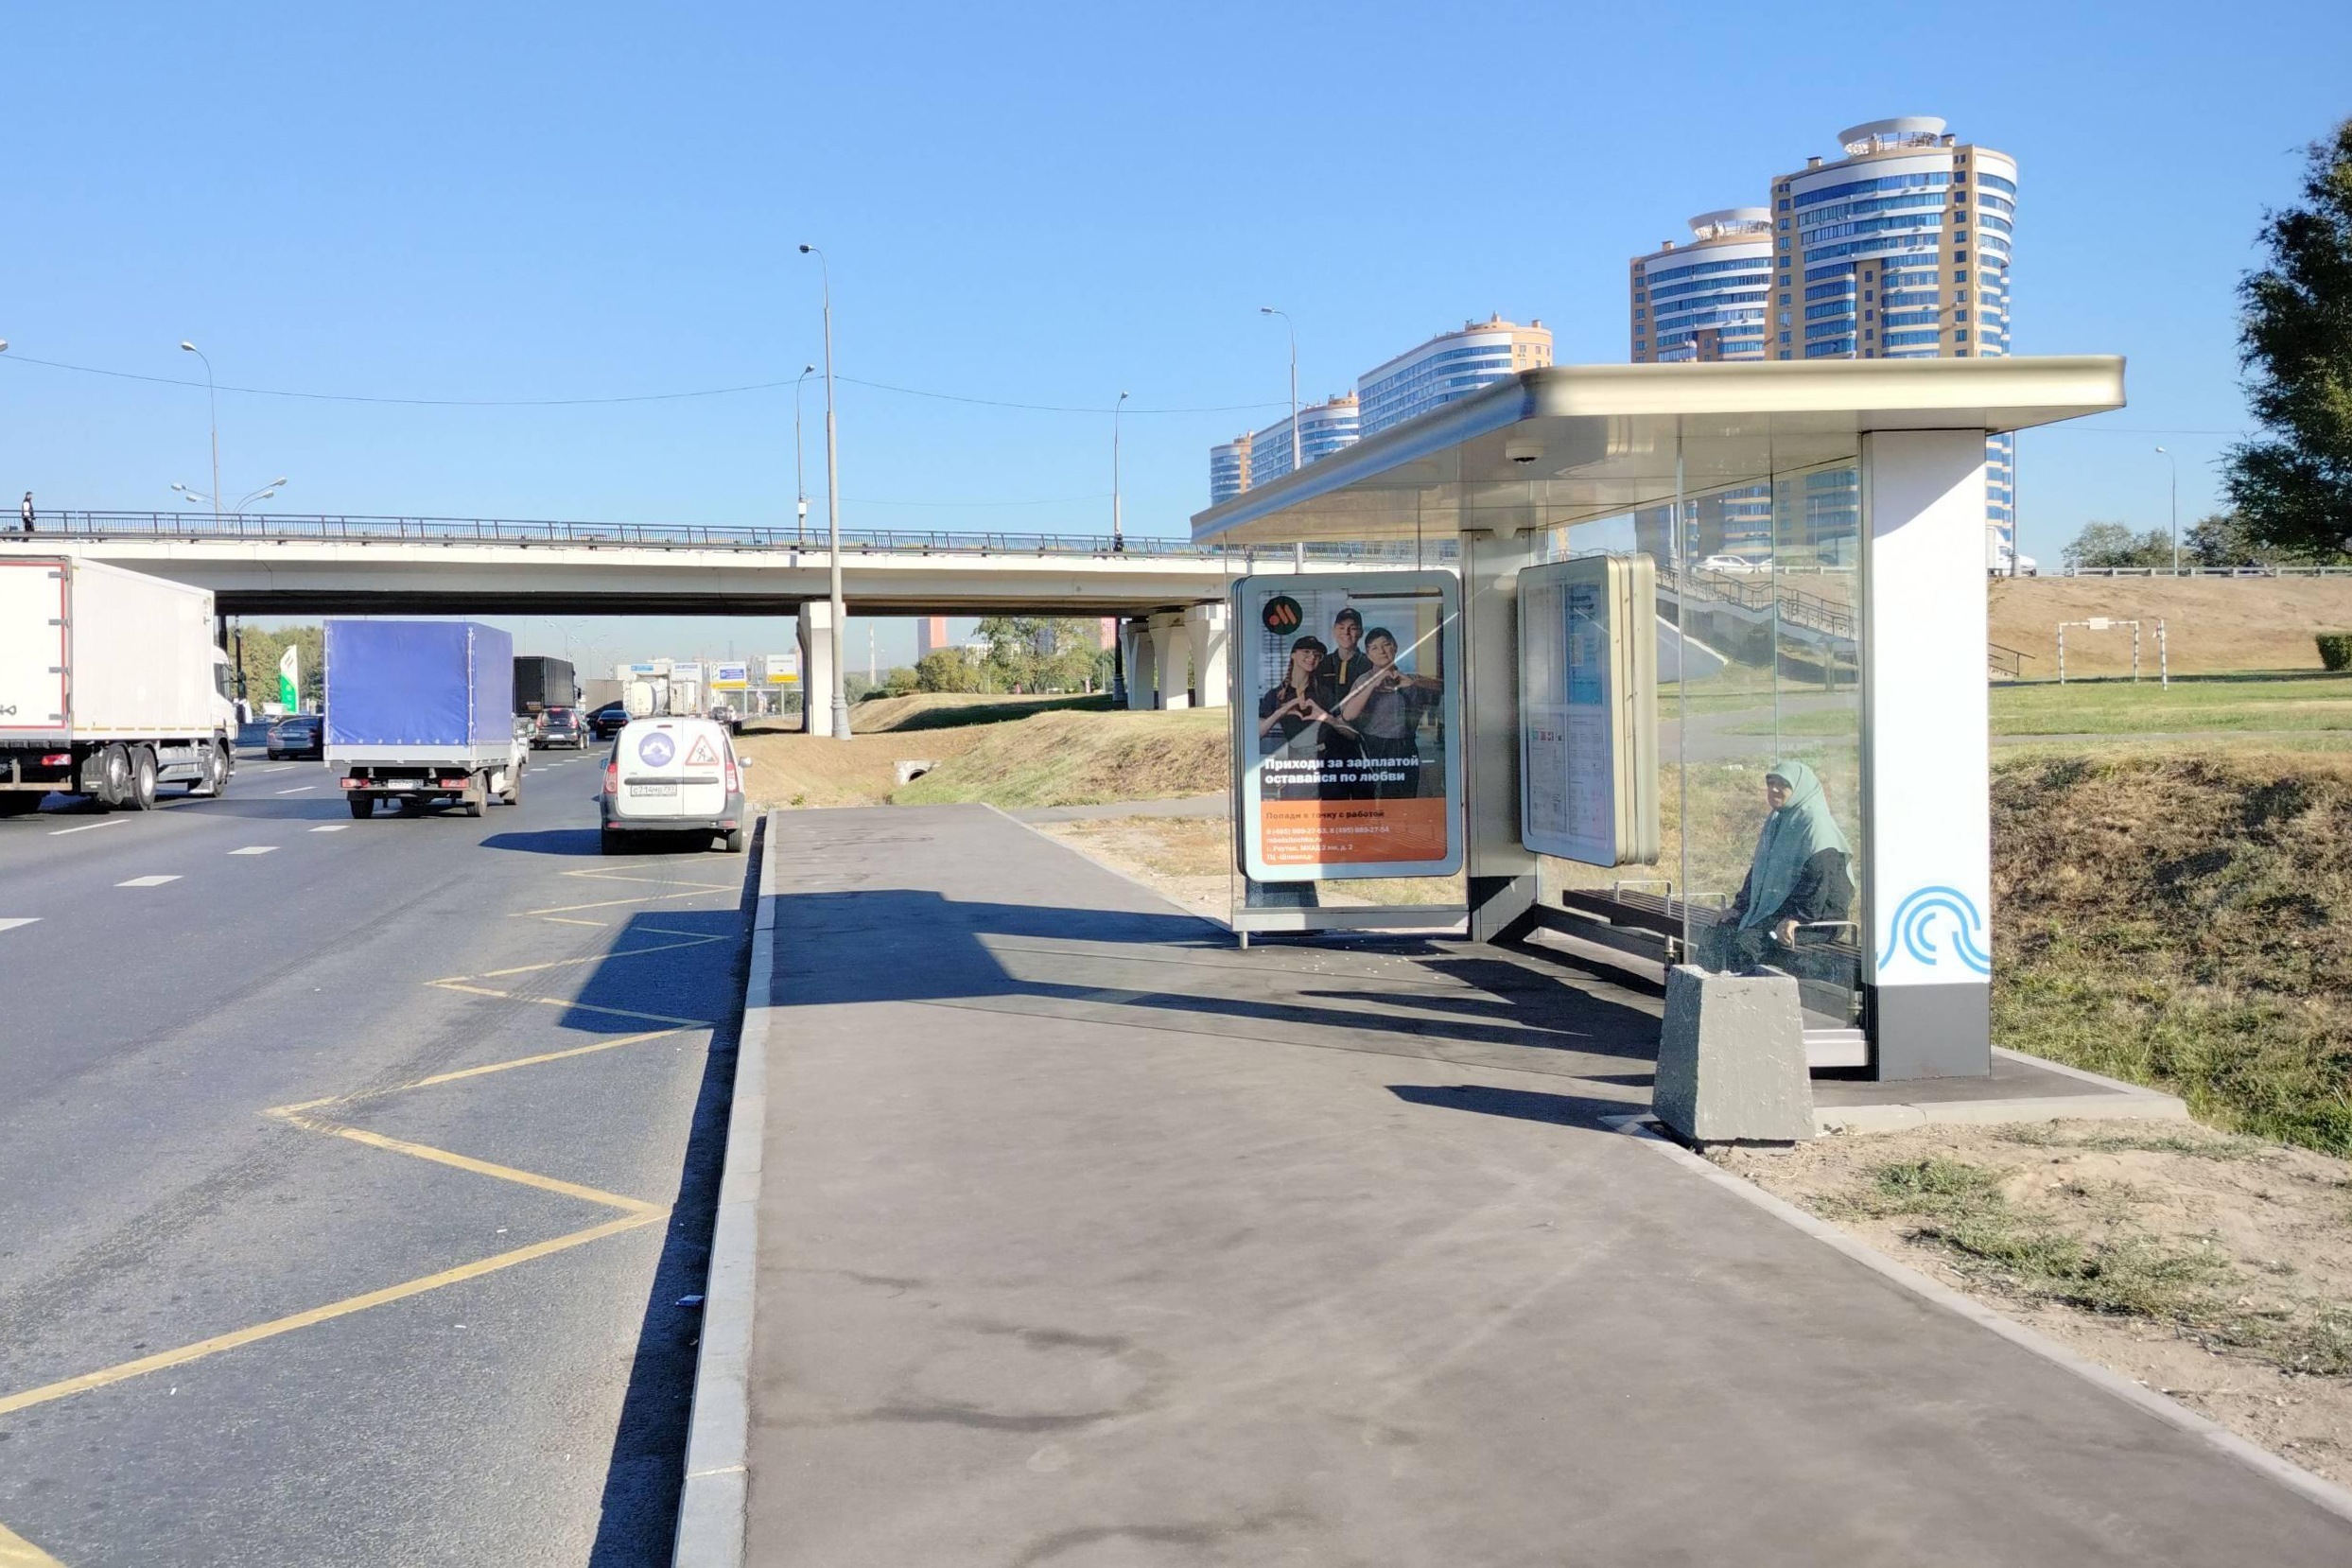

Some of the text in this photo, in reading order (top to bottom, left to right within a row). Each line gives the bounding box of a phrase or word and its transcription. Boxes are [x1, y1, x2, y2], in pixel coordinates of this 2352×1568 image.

[1264, 758, 1324, 771] Приходи
[1327, 759, 1343, 768] за
[1347, 755, 1419, 770] зарплатой
[1264, 771, 1405, 784] оставайся по любви
[1266, 811, 1301, 820] Попади
[1312, 811, 1337, 820] точку
[1346, 809, 1385, 820] работой
